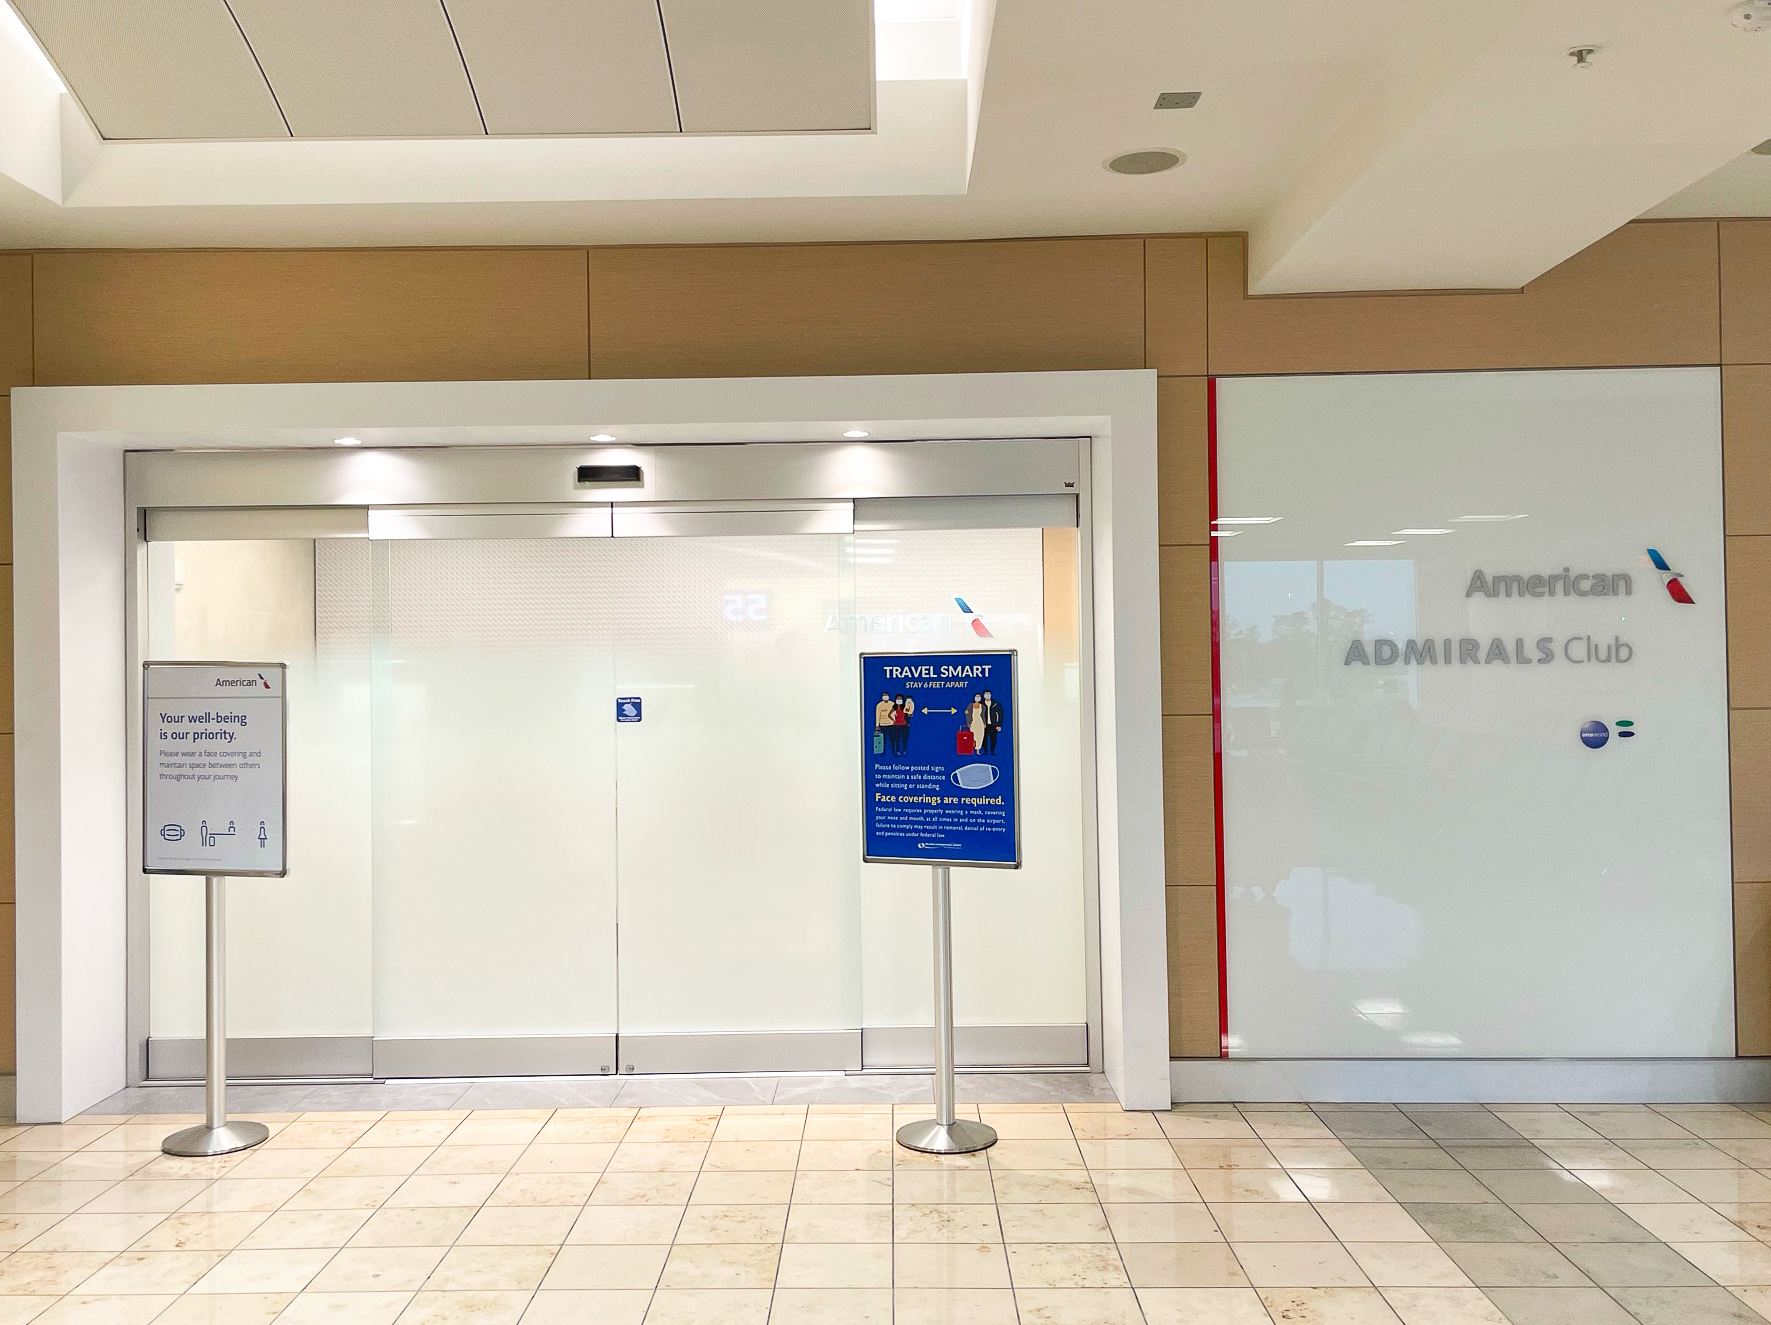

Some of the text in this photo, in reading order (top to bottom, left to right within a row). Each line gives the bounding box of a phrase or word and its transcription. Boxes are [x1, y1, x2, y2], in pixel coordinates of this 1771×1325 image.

[1466, 567, 1633, 598] American
[824, 609, 951, 634] American
[1344, 635, 1634, 666] ADMIRALS Club
[883, 665, 992, 678] TRAVEL SMART
[215, 678, 257, 687] American
[905, 681, 922, 689] STAY
[923, 681, 928, 689] 6
[160, 712, 247, 726] Your well-being
[160, 728, 237, 743] is our priority.
[219, 750, 247, 759] covering
[208, 761, 237, 769] between
[159, 773, 196, 782] throughout
[876, 793, 1005, 807] Face coverings are required.
